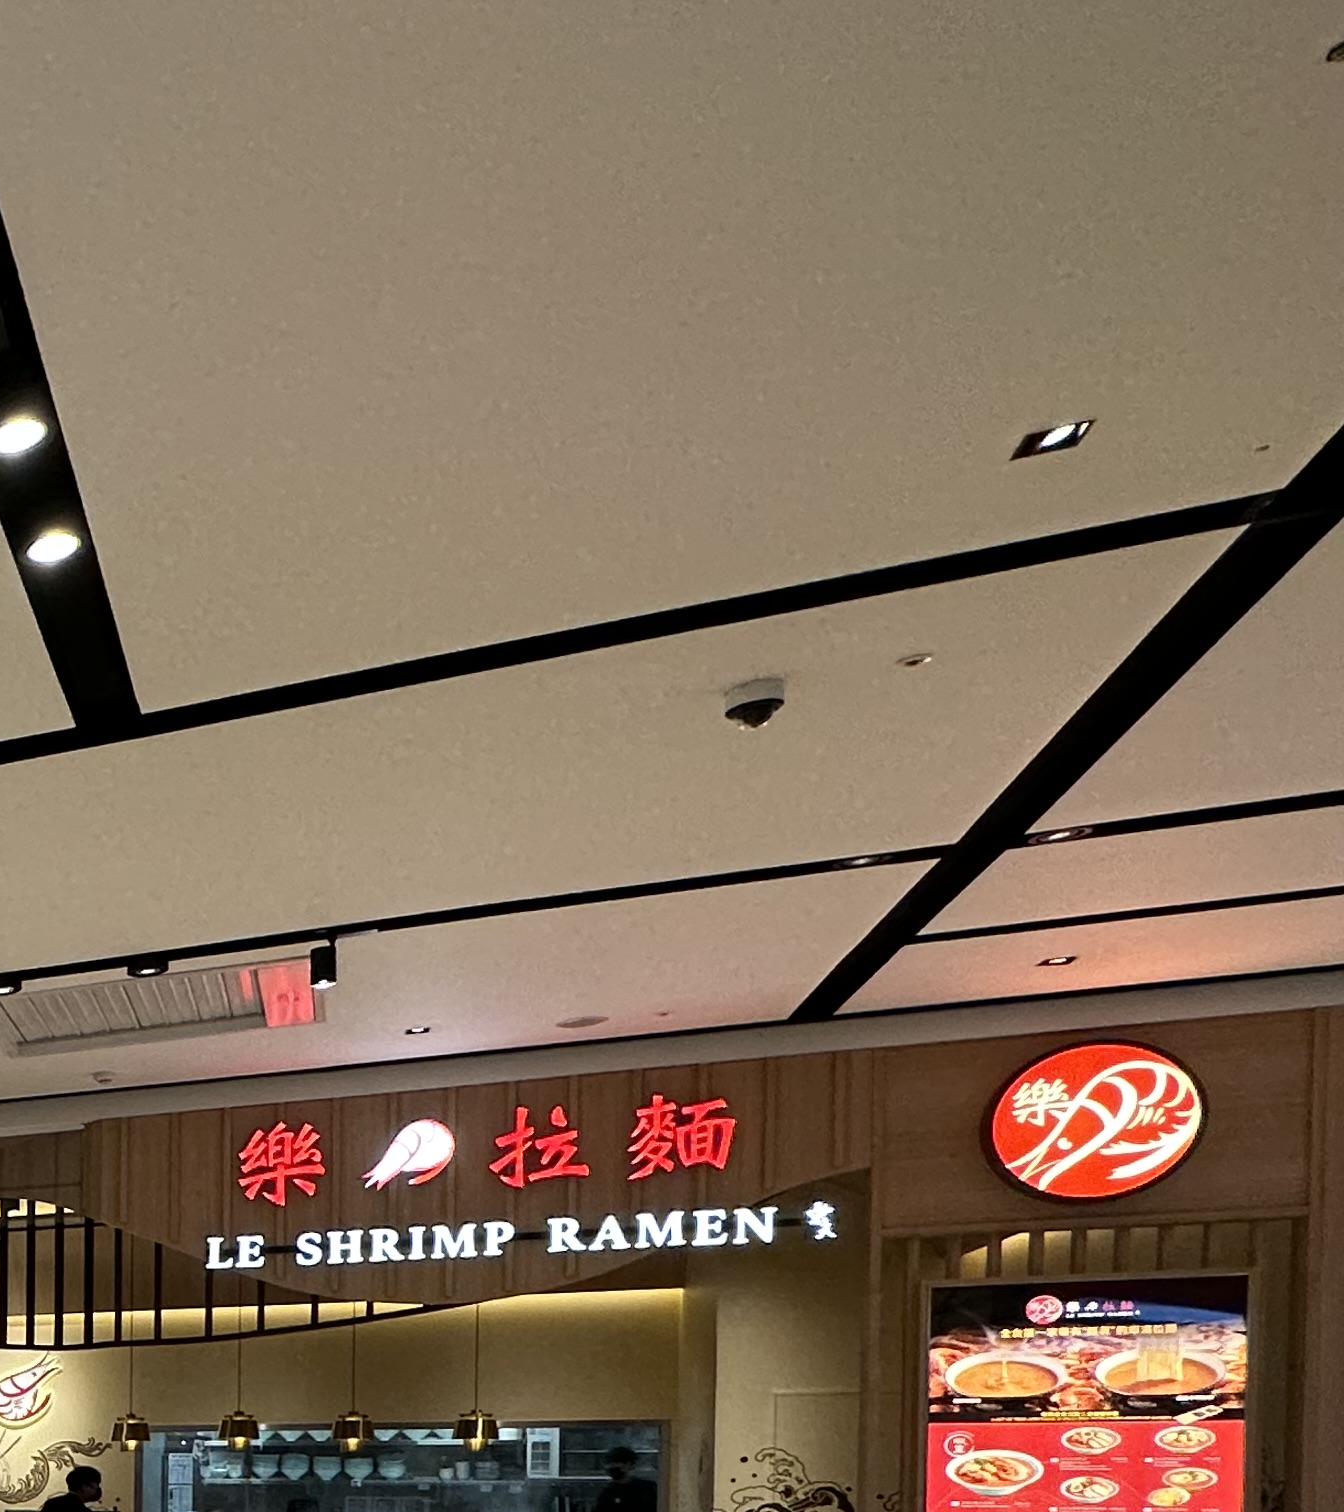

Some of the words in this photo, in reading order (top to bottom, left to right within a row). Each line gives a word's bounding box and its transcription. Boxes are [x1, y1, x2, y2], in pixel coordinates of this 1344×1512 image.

[205, 1235, 266, 1270] LE
[295, 1219, 516, 1267] SHRIMP
[547, 1205, 780, 1255] RAMEN
